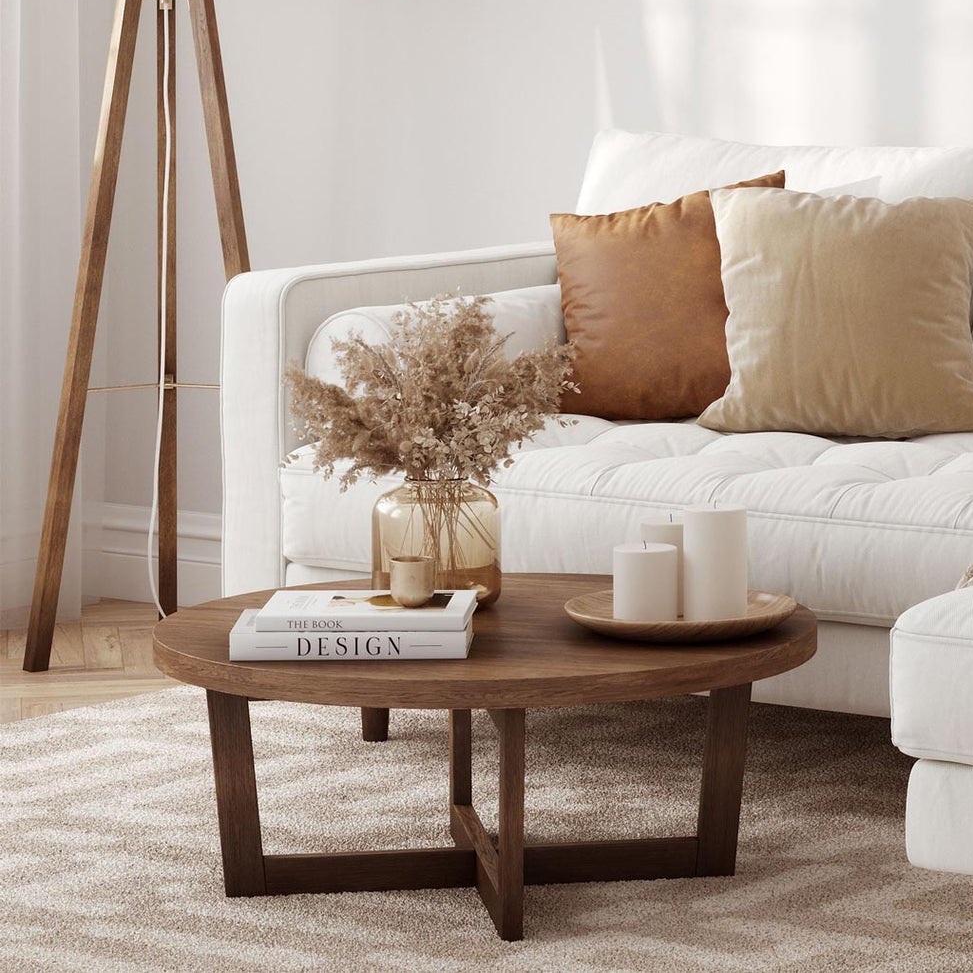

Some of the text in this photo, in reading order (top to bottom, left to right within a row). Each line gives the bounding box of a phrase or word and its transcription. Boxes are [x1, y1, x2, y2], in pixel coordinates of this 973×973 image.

[287, 620, 343, 629] THE BOOK
[297, 636, 401, 656] DESIGN
